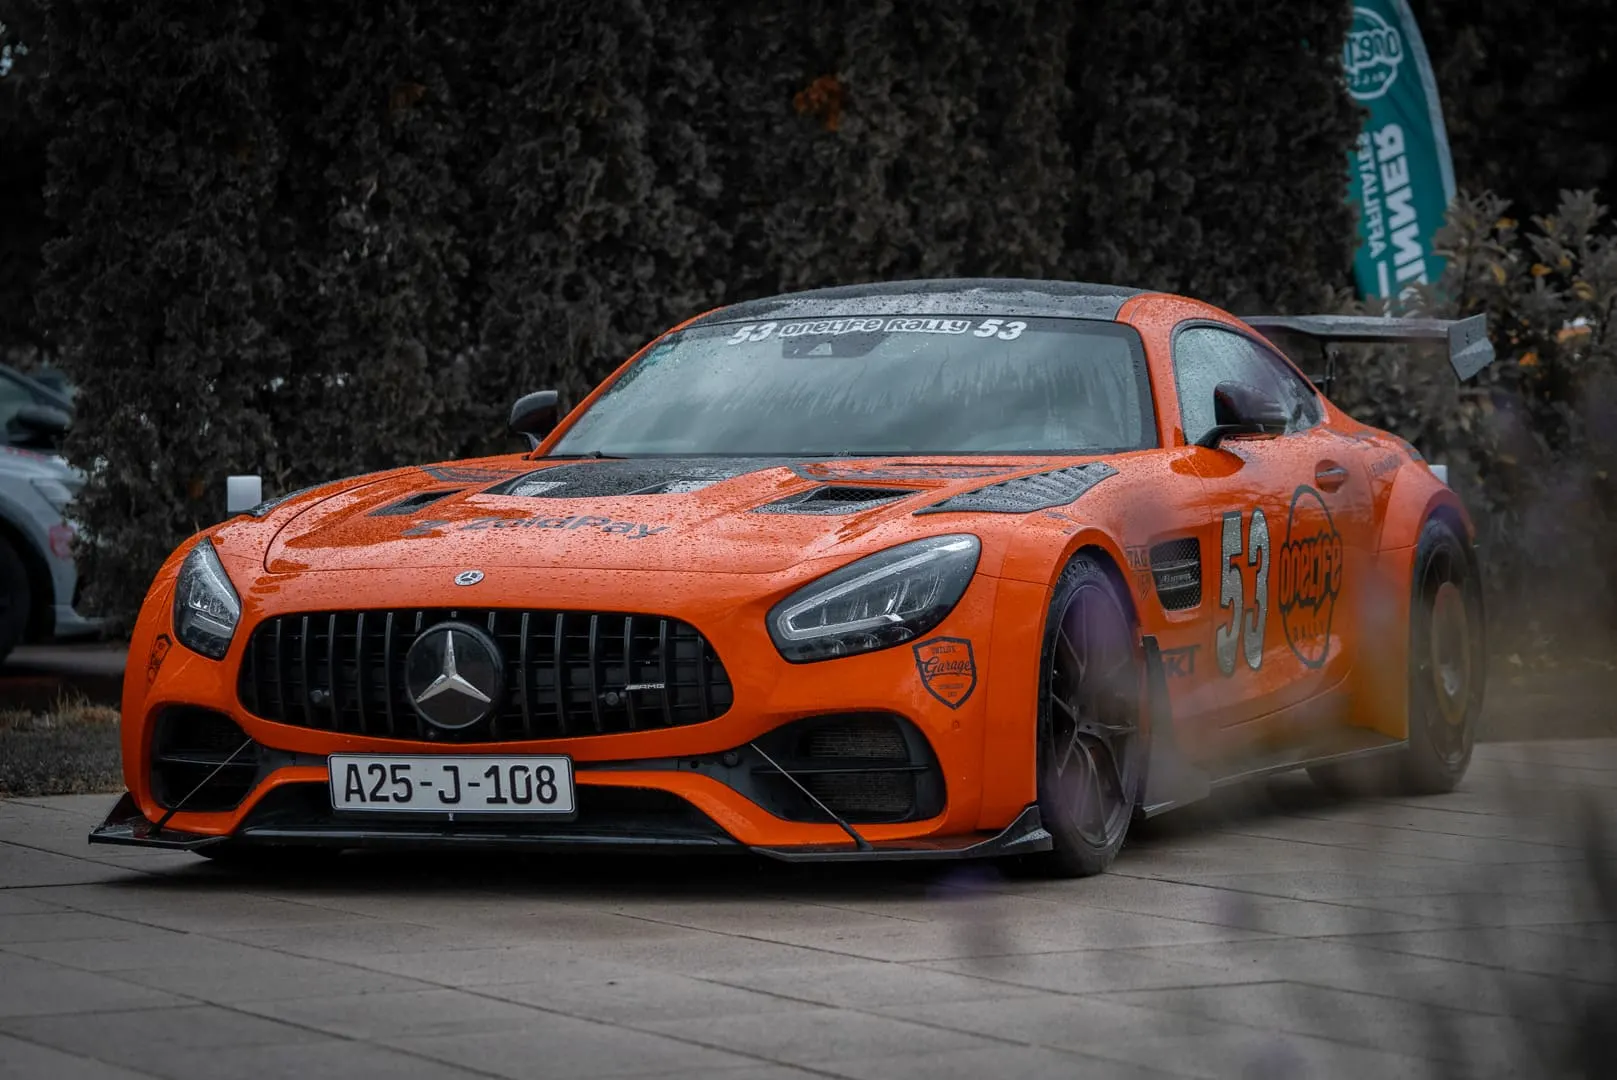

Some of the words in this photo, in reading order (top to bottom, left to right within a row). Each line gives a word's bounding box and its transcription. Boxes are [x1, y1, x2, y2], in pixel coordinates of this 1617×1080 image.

[727, 322, 777, 345] 53
[973, 319, 1027, 341] 53
[1216, 507, 1270, 677] 53
[921, 656, 973, 675] Garage
[345, 763, 558, 804] A25-J-108
